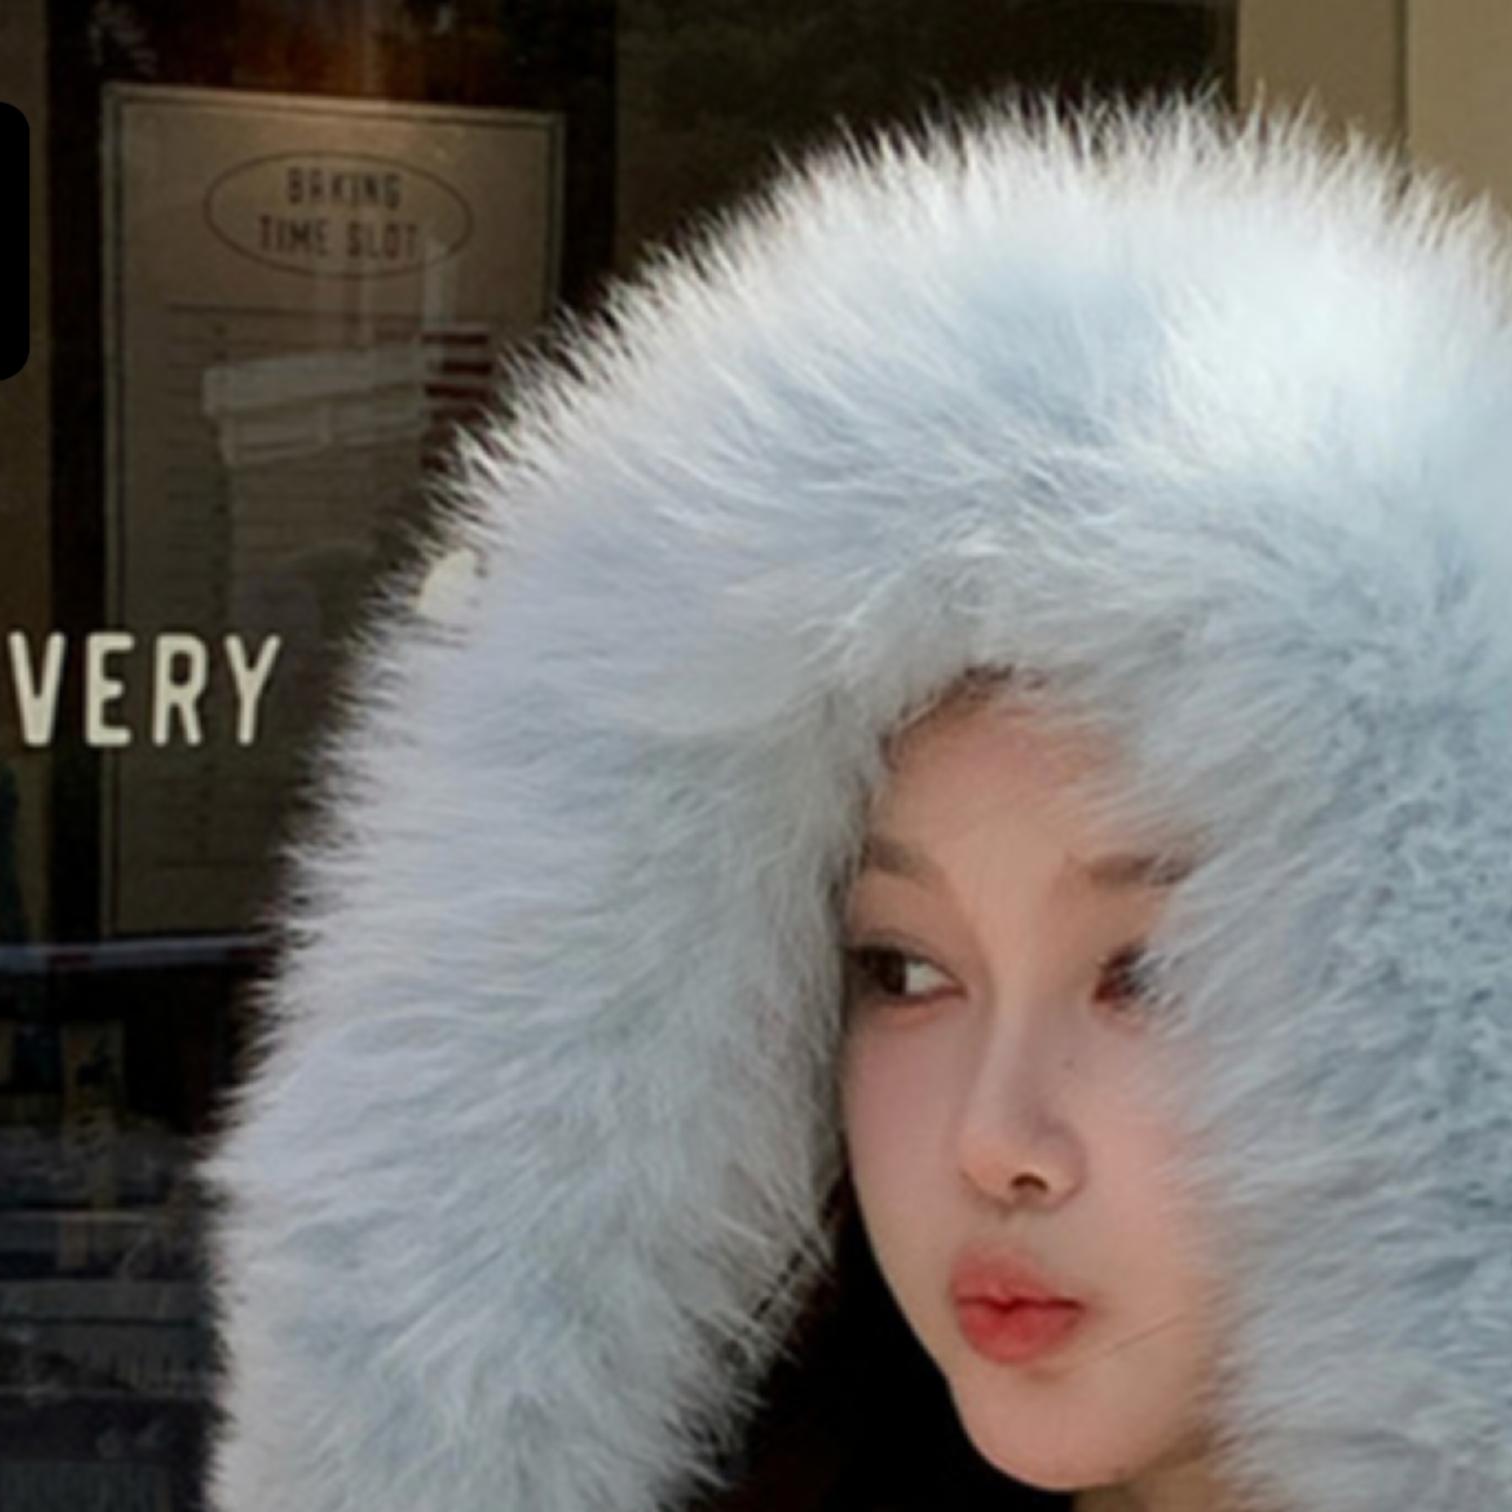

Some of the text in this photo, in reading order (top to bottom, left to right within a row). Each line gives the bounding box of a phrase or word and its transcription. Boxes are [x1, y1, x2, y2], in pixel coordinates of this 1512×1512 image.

[287, 164, 403, 210] BAKING
[259, 214, 419, 260] TIME SLOT
